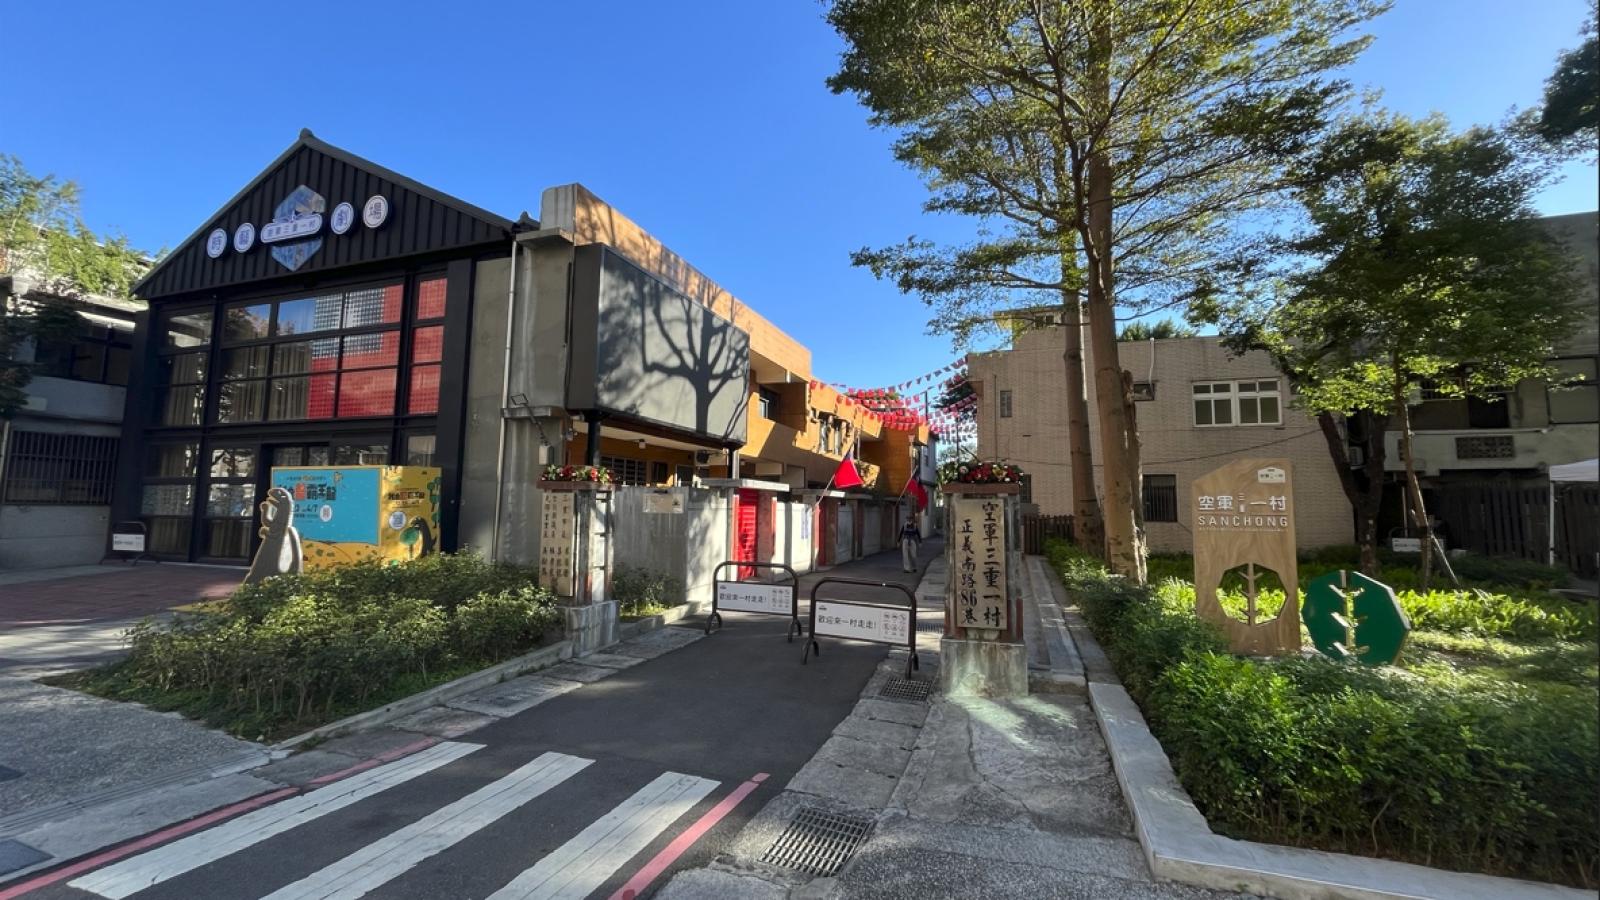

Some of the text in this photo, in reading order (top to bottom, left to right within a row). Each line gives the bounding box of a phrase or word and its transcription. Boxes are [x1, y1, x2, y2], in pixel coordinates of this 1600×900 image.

[960, 518, 978, 625] 正義南路86巷
[982, 502, 1001, 627] 空軍三重一村
[1198, 515, 1288, 527] SANCHONG
